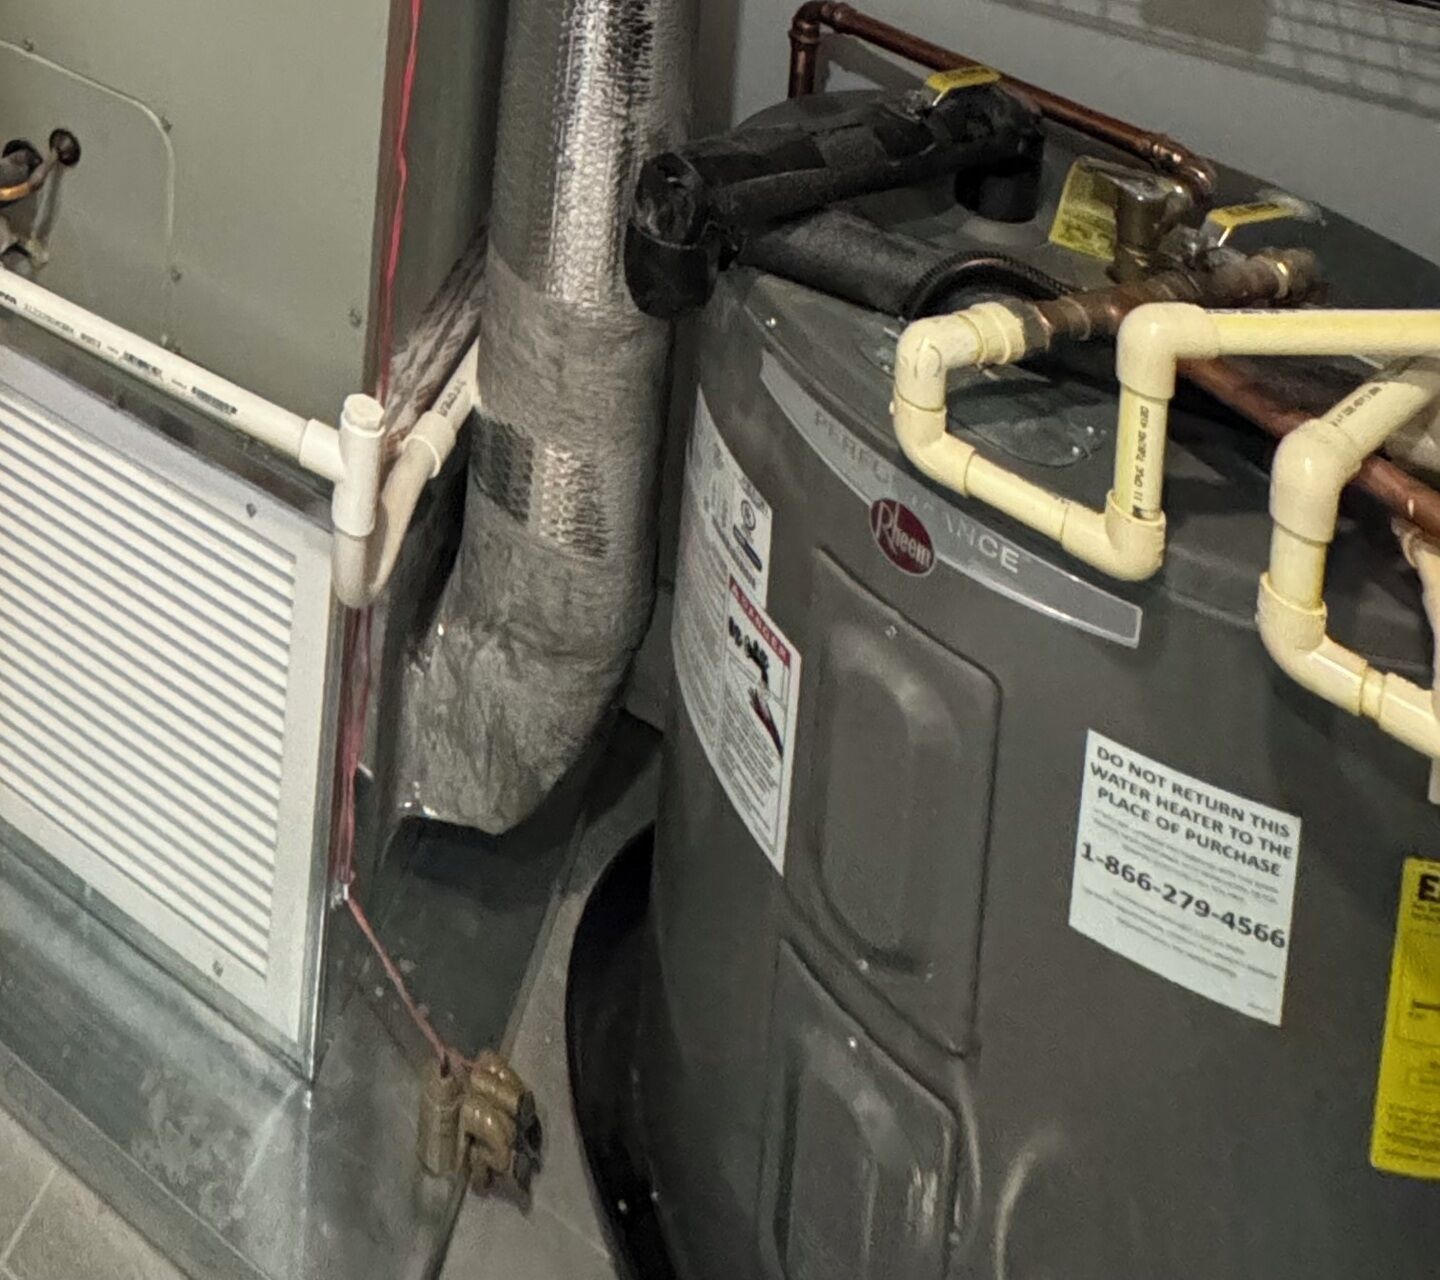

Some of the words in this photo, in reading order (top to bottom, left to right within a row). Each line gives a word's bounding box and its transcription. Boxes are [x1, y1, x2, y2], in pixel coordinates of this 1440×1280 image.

[873, 498, 933, 569] Rheem
[1090, 761, 1150, 801] WATER
[1156, 794, 1223, 834] HEATER
[1229, 825, 1254, 845] TO
[1259, 836, 1293, 860] THE
[1097, 745, 1124, 768] DO
[1129, 760, 1166, 789] NOT
[1172, 782, 1244, 822] RETURN
[1250, 812, 1291, 838] THIS
[1098, 787, 1150, 822] PLACE
[1156, 816, 1180, 834] OF
[1185, 828, 1281, 877] PURCHASE
[1080, 841, 1286, 949] 1-866-279-4566
